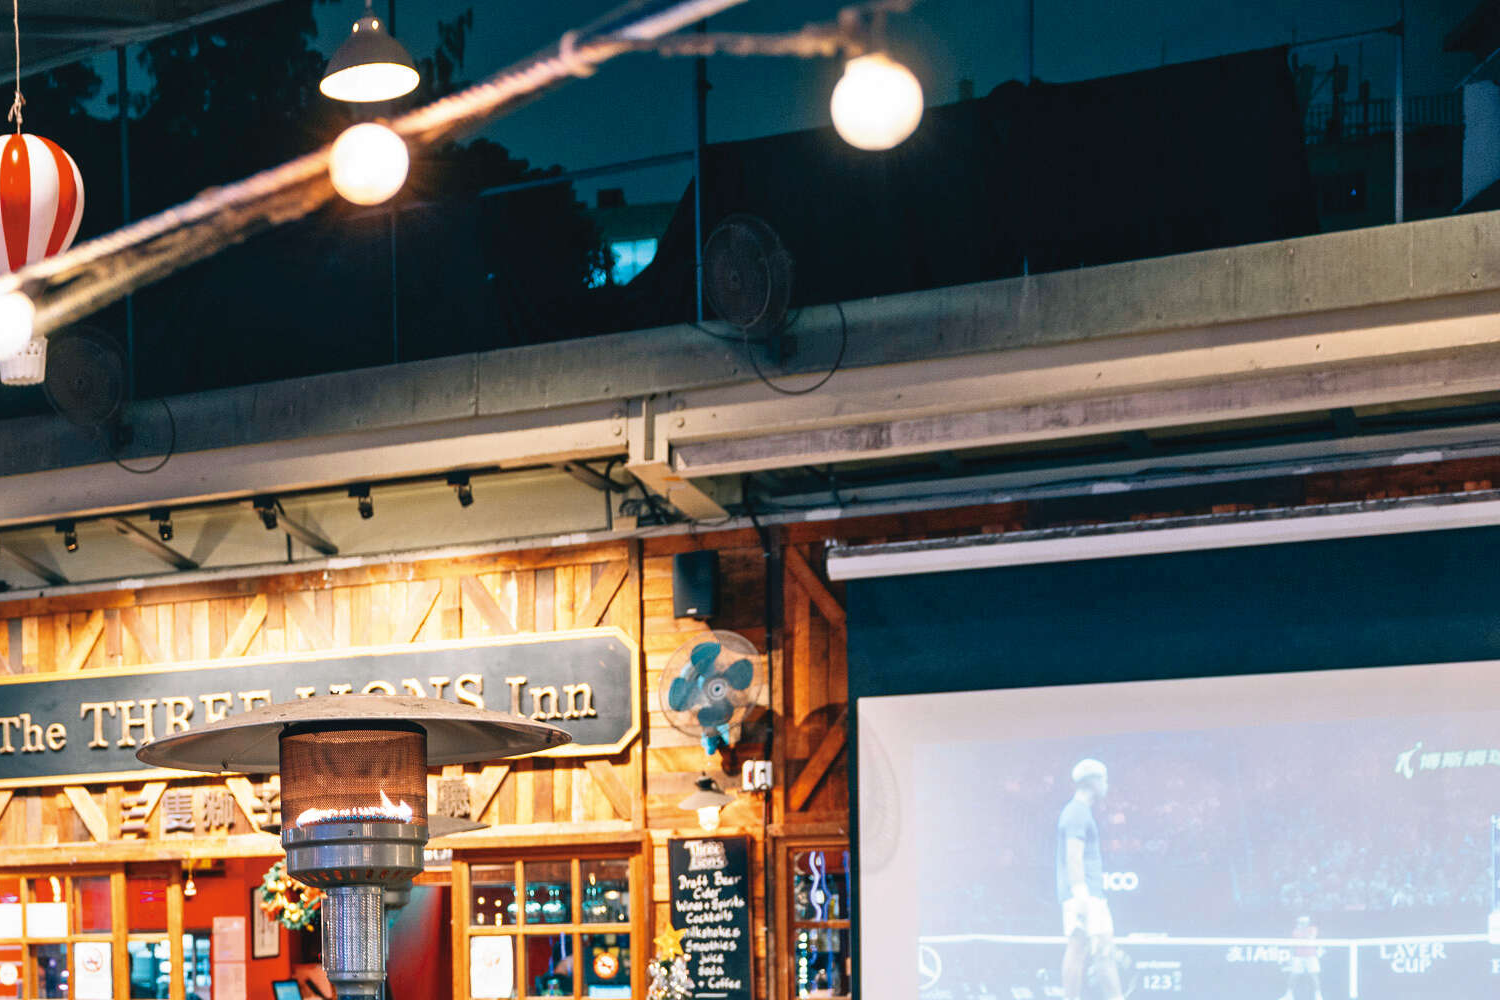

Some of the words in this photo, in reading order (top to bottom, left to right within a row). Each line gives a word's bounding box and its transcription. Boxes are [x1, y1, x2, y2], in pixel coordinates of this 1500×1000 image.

[505, 675, 597, 720] Inn
[678, 874, 708, 890] Draft
[713, 871, 742, 887] Beer
[693, 887, 722, 900] Cider
[685, 910, 734, 924] Cocktails
[685, 939, 737, 953] Smoothies
[1379, 943, 1447, 960] LAVER
[1390, 958, 1433, 974] CUP
[708, 977, 742, 989] Coffee
